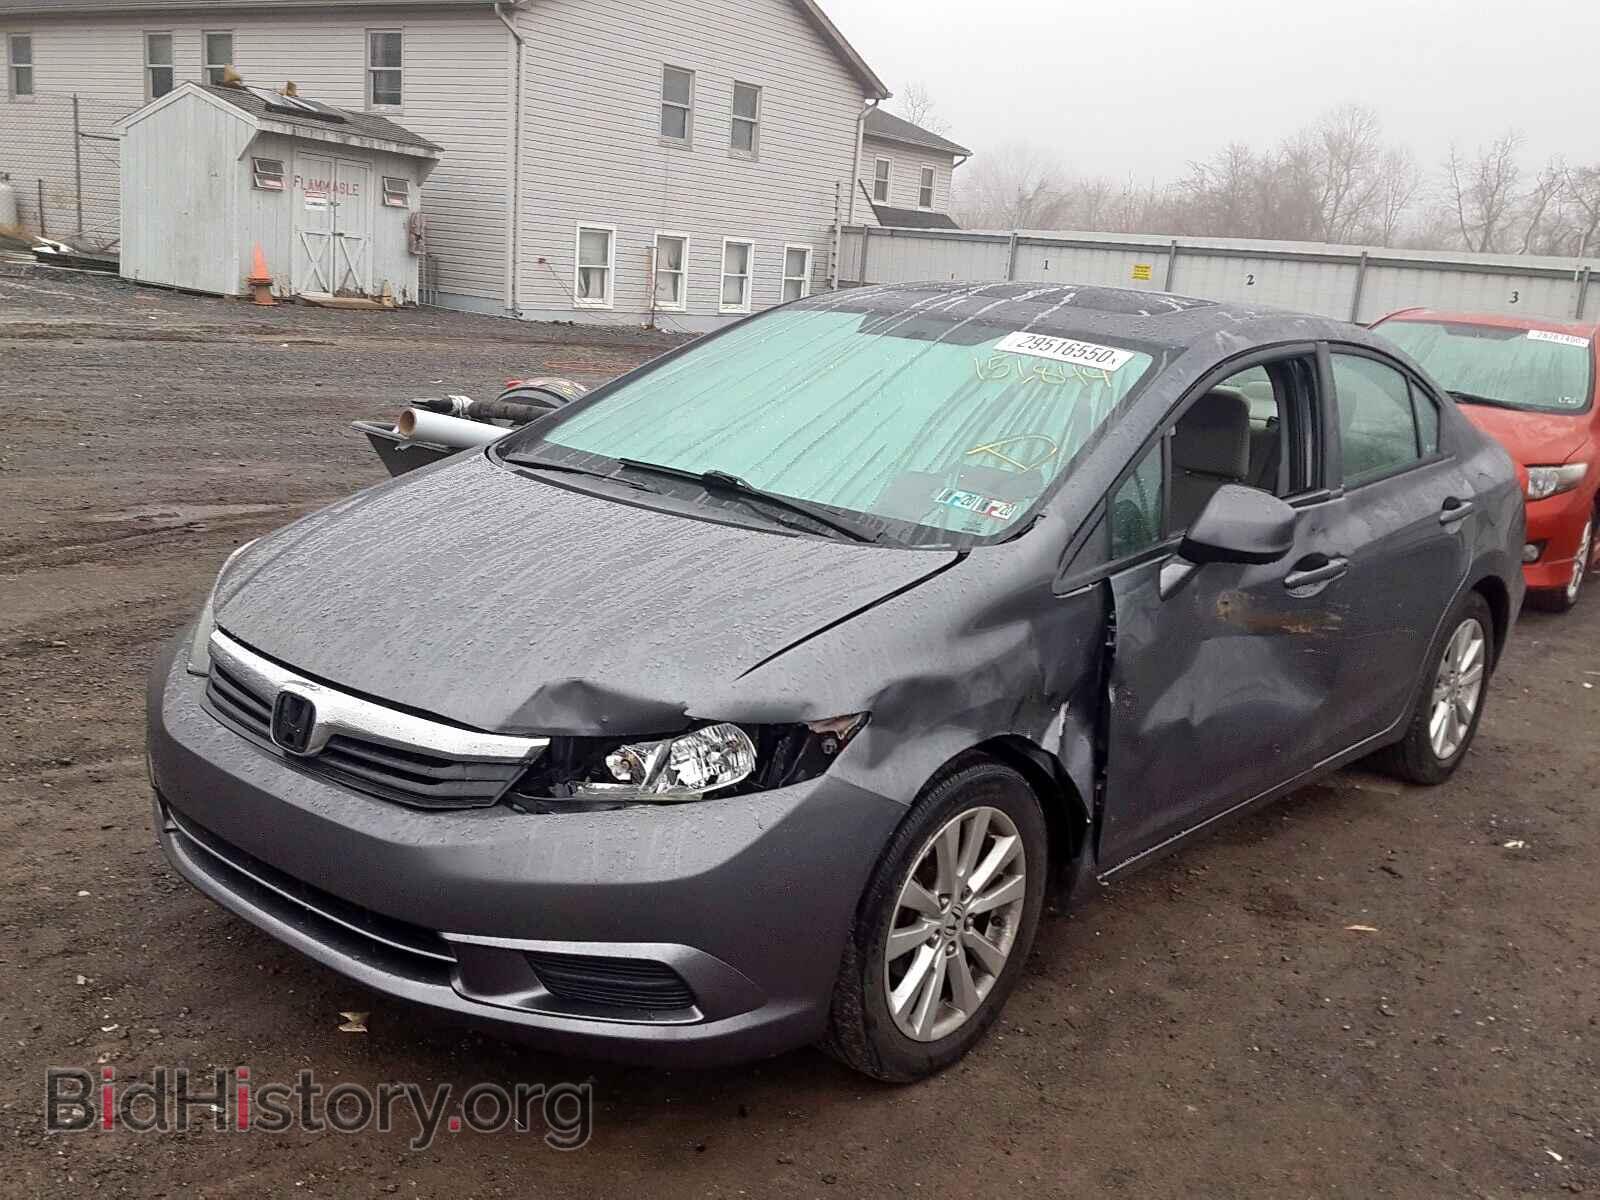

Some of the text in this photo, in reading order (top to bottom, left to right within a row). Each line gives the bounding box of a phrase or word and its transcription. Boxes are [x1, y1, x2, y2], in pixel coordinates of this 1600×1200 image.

[1246, 274, 1255, 285] 2
[1508, 291, 1519, 304] 3
[1016, 335, 1114, 363] 29516550
